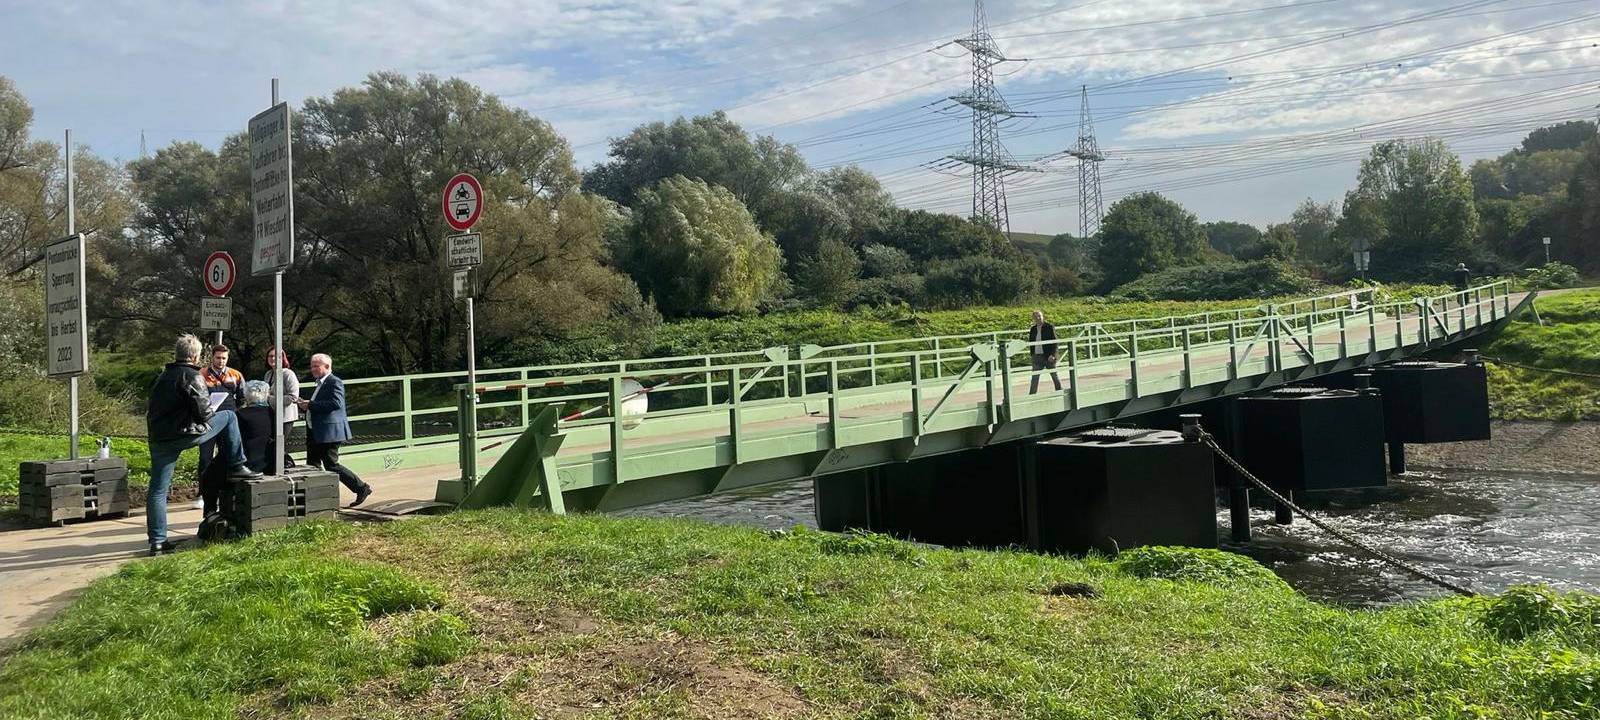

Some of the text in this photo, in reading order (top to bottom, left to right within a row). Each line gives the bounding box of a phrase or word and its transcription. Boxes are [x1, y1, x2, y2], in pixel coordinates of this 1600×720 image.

[256, 193, 286, 216] Weiterfahrt
[256, 213, 287, 240] FR Wiesdorf
[51, 271, 74, 288] Sperrung
[213, 265, 225, 283] 6 t
[60, 319, 77, 335] Herbst
[57, 346, 73, 363] 2023
